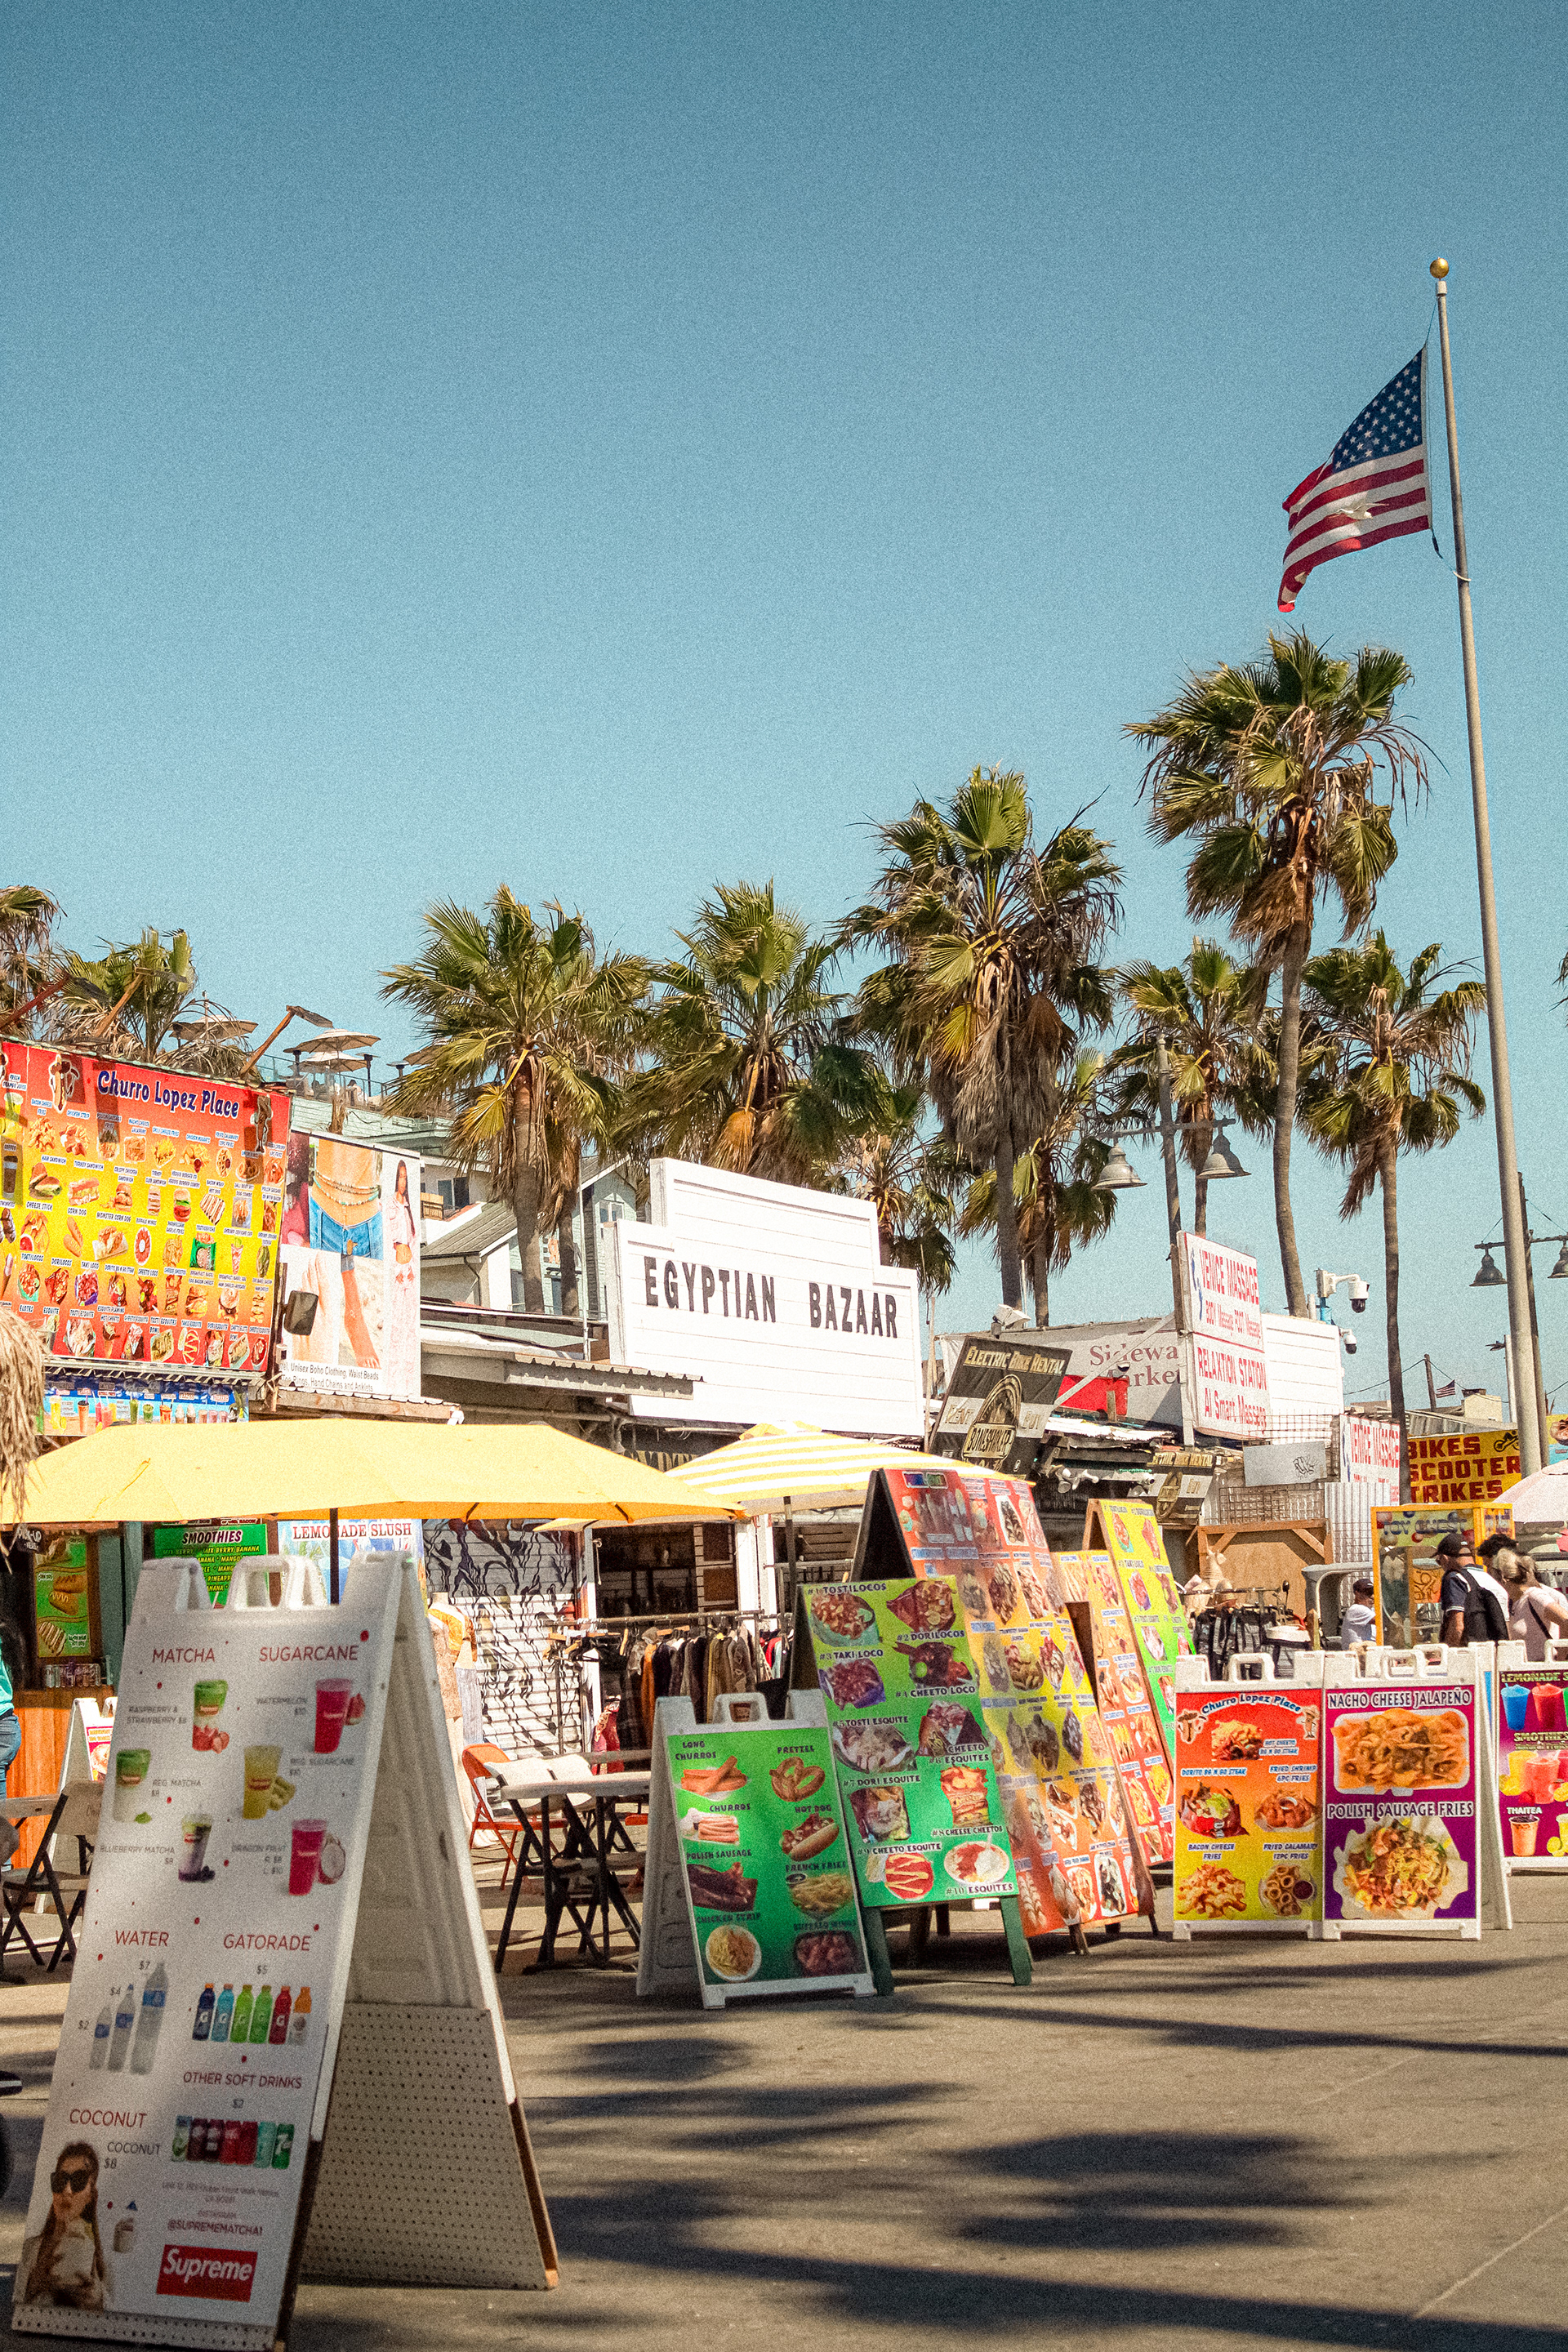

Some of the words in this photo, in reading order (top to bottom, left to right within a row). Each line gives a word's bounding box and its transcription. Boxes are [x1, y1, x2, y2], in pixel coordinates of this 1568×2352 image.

[98, 1071, 149, 1101] Churro
[155, 1081, 197, 1112] Lopez
[201, 1090, 239, 1118] Place
[1226, 1258, 1259, 1305] MASSAGE
[644, 1256, 776, 1323] EGYPTIAN
[809, 1282, 898, 1338] BAZAAR
[964, 1346, 1010, 1370] ELECTRIC
[1030, 1354, 1065, 1375] RENTAL
[291, 1363, 309, 1373] Unisex
[310, 1365, 323, 1374] Boho
[349, 1370, 363, 1379] Waist
[364, 1371, 379, 1380] Beads
[1197, 1347, 1237, 1384] RELAXTION
[1238, 1357, 1267, 1390] STATION
[1107, 1365, 1184, 1388] arket
[1214, 1390, 1236, 1422] Smart
[1408, 1436, 1481, 1459] BIKES
[1410, 1480, 1503, 1503] TRIKES
[182, 1529, 243, 1544] SMOOTHIES
[292, 1524, 367, 1539] LEMOADE
[371, 1522, 412, 1537] SLUSH
[822, 1583, 887, 1593] TOSTILOCOS
[911, 1630, 965, 1641] DORILOCOS
[152, 1648, 216, 1663] MATCHA
[259, 1646, 359, 1662] SUGARCANE
[858, 1649, 884, 1658] LOCO
[1501, 1673, 1561, 1682] LEMONADE
[911, 1687, 947, 1697] CHEETO
[951, 1686, 976, 1695] LOCO
[1329, 1693, 1369, 1708] NACHO
[1372, 1692, 1411, 1706] CHEESE
[1413, 1689, 1471, 1708] JALAPEÑO
[1201, 1697, 1236, 1713] Churro
[1240, 1695, 1270, 1704] Lopez
[1273, 1696, 1301, 1712] Place
[846, 1718, 870, 1726] TOSTI
[873, 1716, 909, 1724] ESQUITE
[1514, 1732, 1568, 1742] SMOTHIES
[777, 1745, 815, 1753] PRETZEL
[948, 1744, 985, 1753] CHEETO
[675, 1752, 716, 1760] CHURROS
[945, 1754, 989, 1763] ESQUITES
[858, 1778, 880, 1786] DORI
[883, 1775, 920, 1784] ESQUITE
[709, 1803, 751, 1812] CHURROS
[814, 1804, 831, 1812] DOG
[1328, 1805, 1374, 1818] POLISH
[1379, 1802, 1435, 1816] SAUSAGE
[1438, 1802, 1473, 1815] FRIES
[973, 1826, 1003, 1834] CHEETOS
[687, 1851, 715, 1860] POLISH
[715, 1849, 752, 1859] SAUSAGE
[872, 1846, 905, 1854] CHEETO
[907, 1842, 941, 1851] ESQUITE
[969, 1884, 1013, 1894] ESQUITES
[115, 1930, 169, 1947] WATER
[223, 1934, 311, 1951] GATORADE
[139, 1961, 150, 1971] $7
[256, 1965, 268, 1975] $5
[78, 2020, 90, 2030] $2
[183, 2071, 223, 2086] OTHER
[225, 2073, 256, 2087] SOFT
[258, 2075, 303, 2089] DRINKS
[69, 2109, 148, 2129] COCONUT
[107, 2141, 161, 2155] COCONUT
[163, 2248, 252, 2283] Supreme
